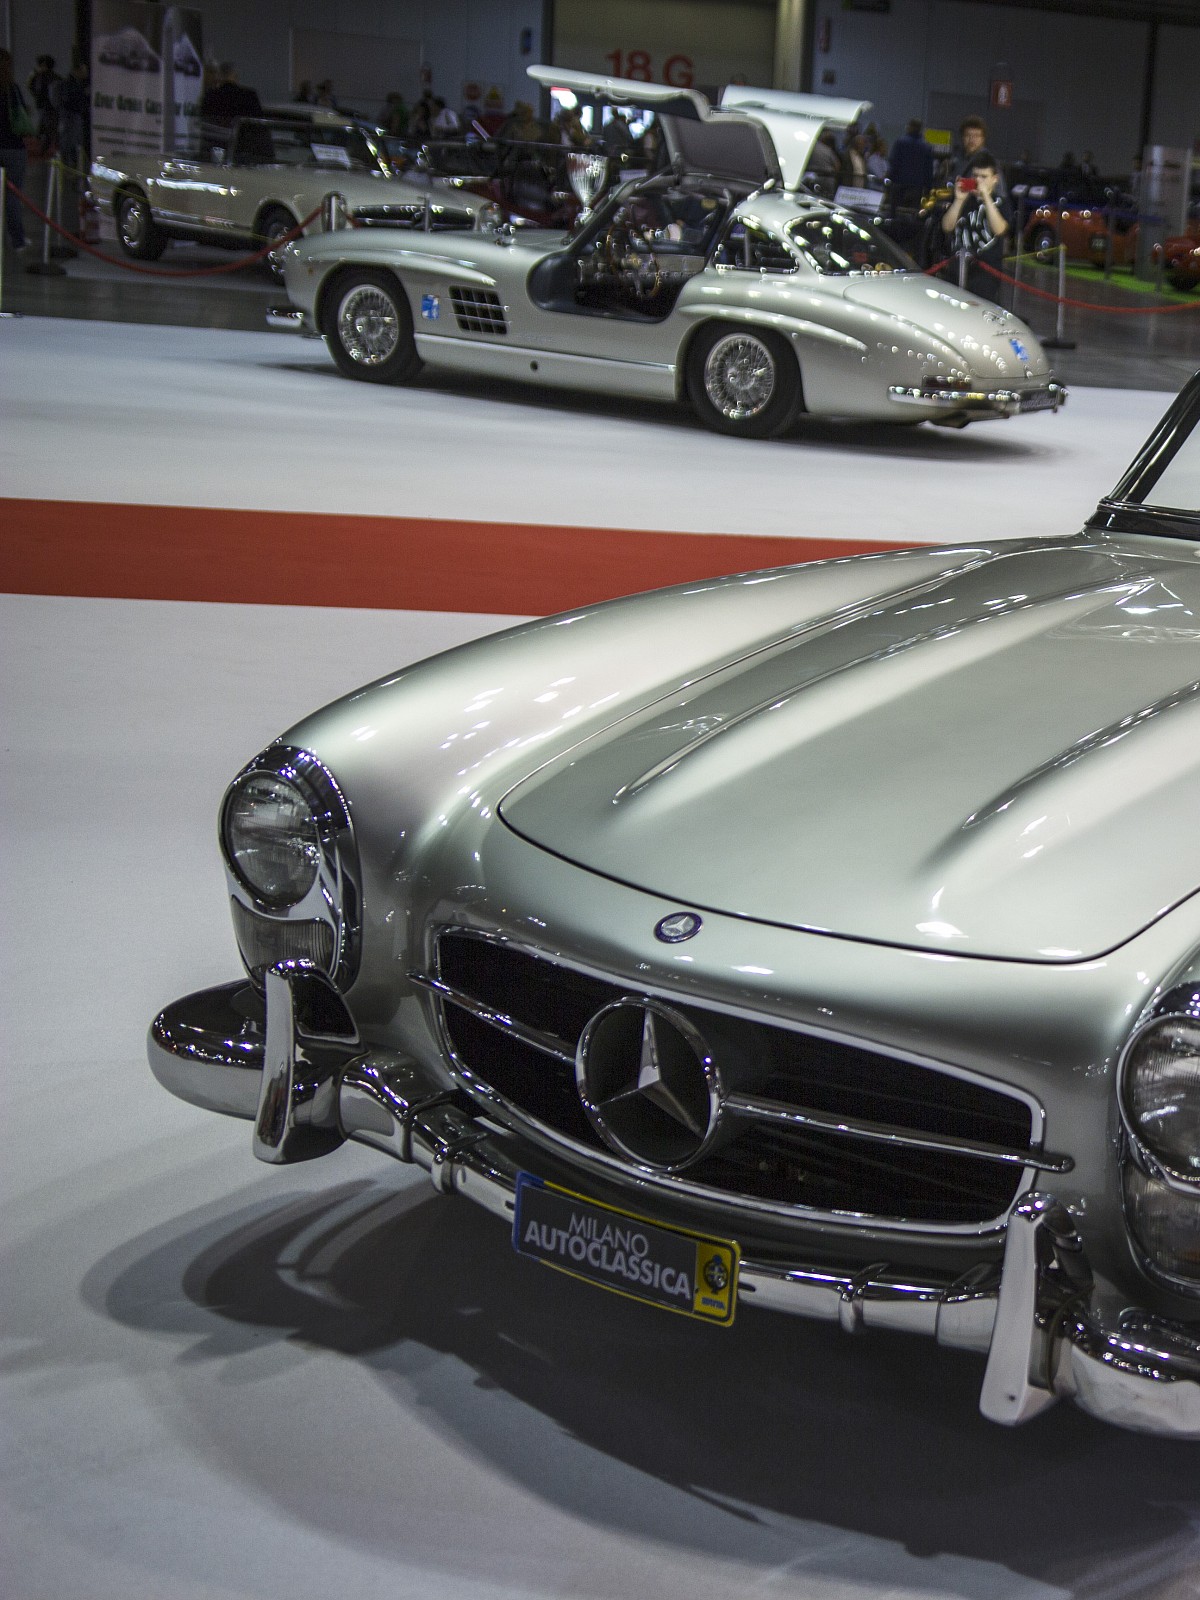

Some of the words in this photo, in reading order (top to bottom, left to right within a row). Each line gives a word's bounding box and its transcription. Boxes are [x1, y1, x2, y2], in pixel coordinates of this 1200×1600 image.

[605, 47, 652, 82] 18
[663, 53, 694, 89] G
[569, 1212, 649, 1257] MILANO
[523, 1220, 691, 1299] AUTOCLASSICA
